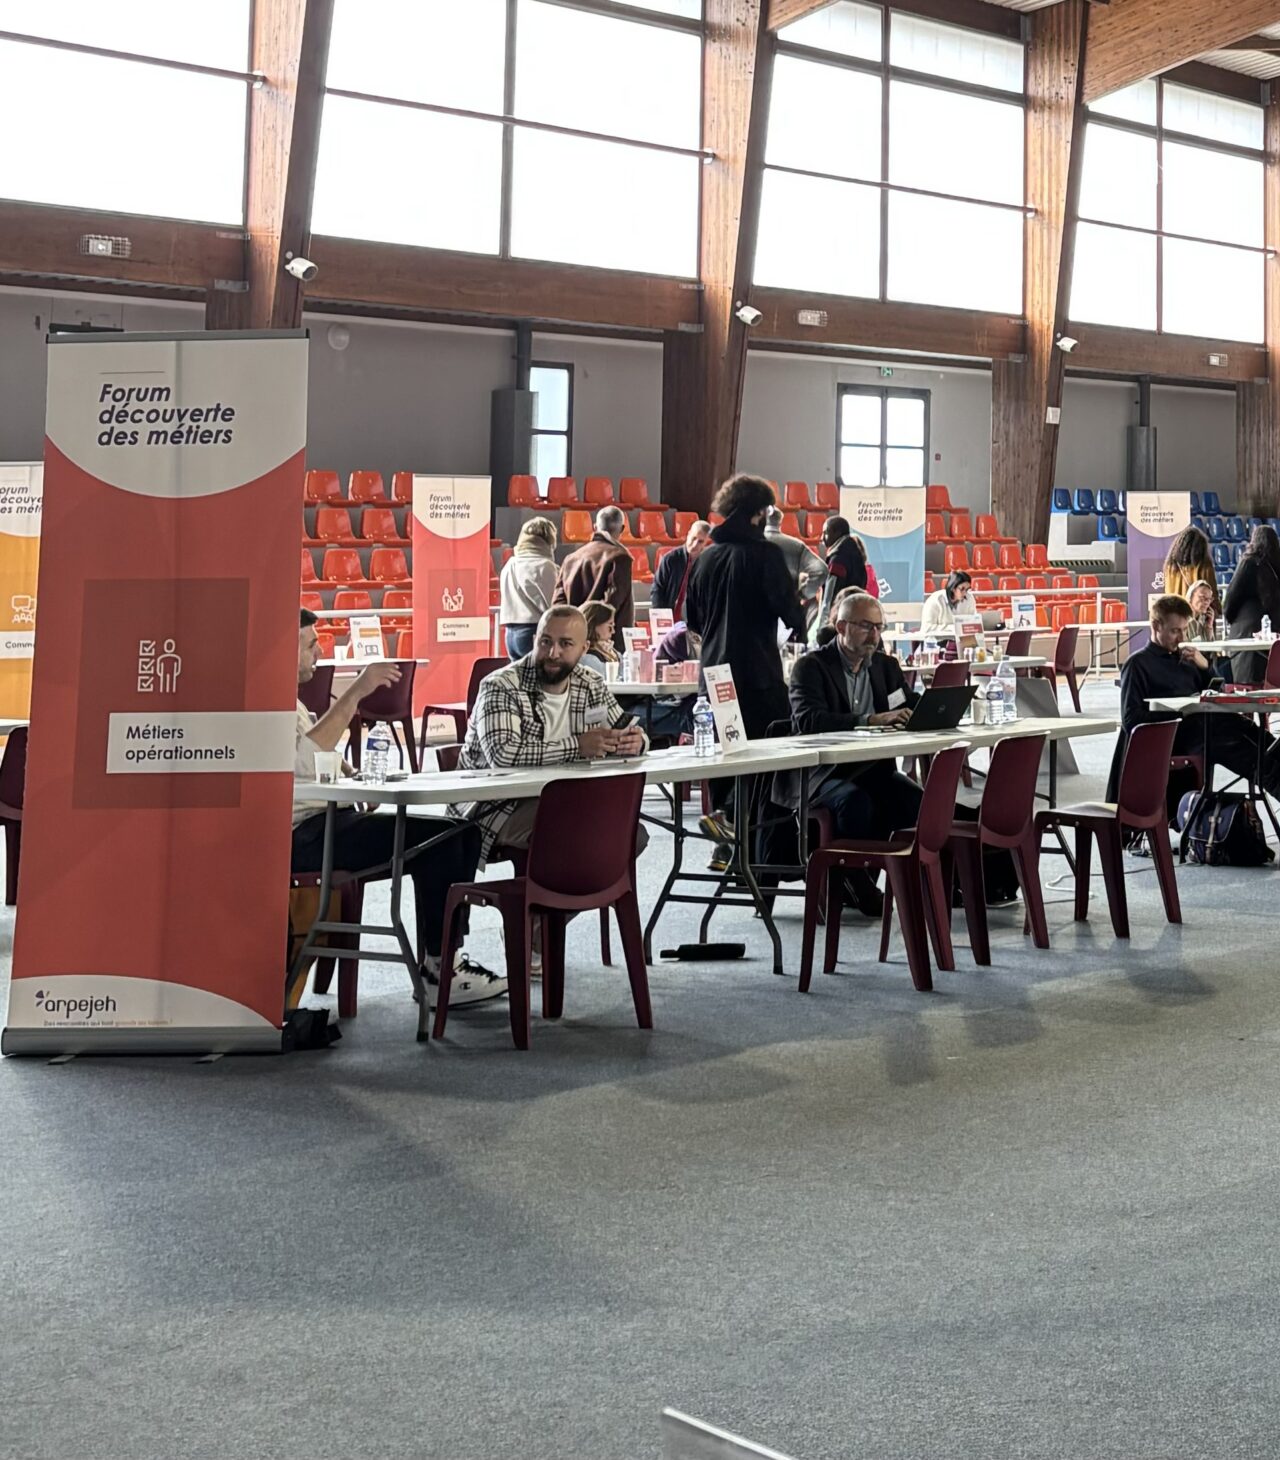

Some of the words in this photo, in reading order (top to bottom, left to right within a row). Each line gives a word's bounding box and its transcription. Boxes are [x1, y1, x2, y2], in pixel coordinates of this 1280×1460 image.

[99, 384, 171, 402] Forum
[98, 403, 236, 424] découverte
[97, 426, 139, 446] des
[147, 423, 233, 445] métiers
[0, 486, 29, 495] orum
[0, 505, 13, 514] es
[4, 641, 34, 649] Comm
[126, 723, 184, 740] Métiers
[125, 744, 236, 763] opérationnels
[45, 995, 117, 1019] arpejeh
